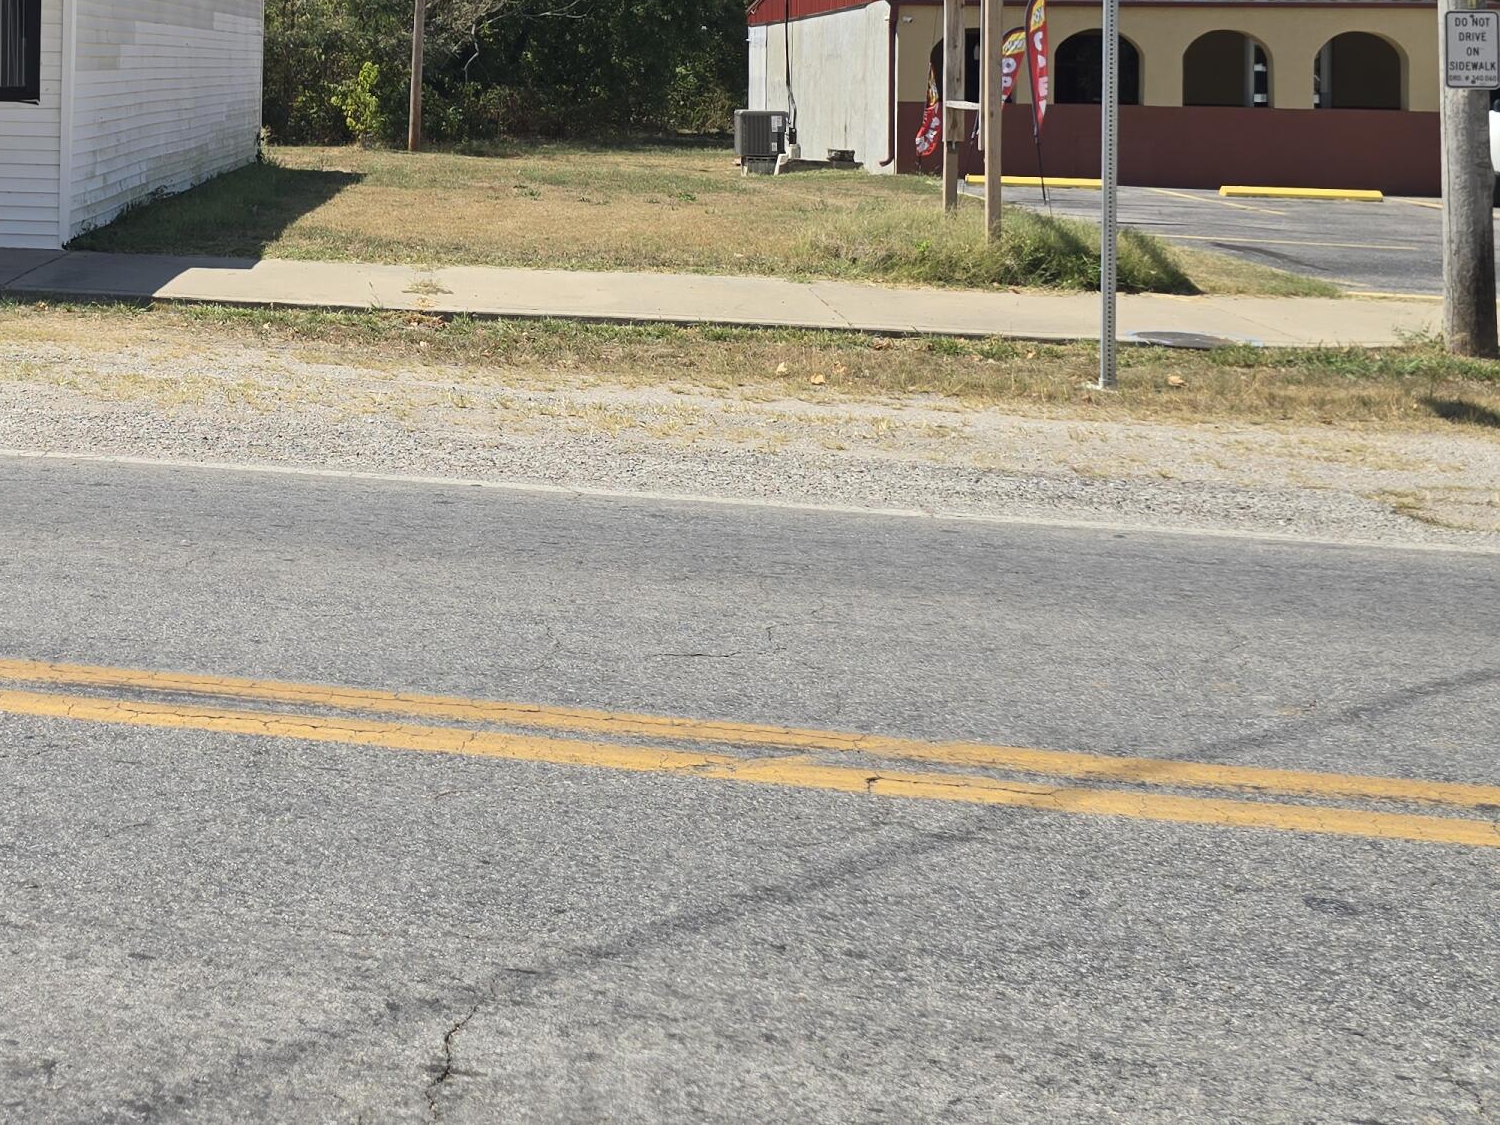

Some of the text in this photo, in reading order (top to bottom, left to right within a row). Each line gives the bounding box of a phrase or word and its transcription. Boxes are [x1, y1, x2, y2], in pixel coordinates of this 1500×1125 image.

[1454, 17, 1491, 27] DO NOT
[1458, 32, 1487, 42] DRIVE
[1466, 47, 1480, 56] ON
[1449, 61, 1497, 71] SIDEWALK
